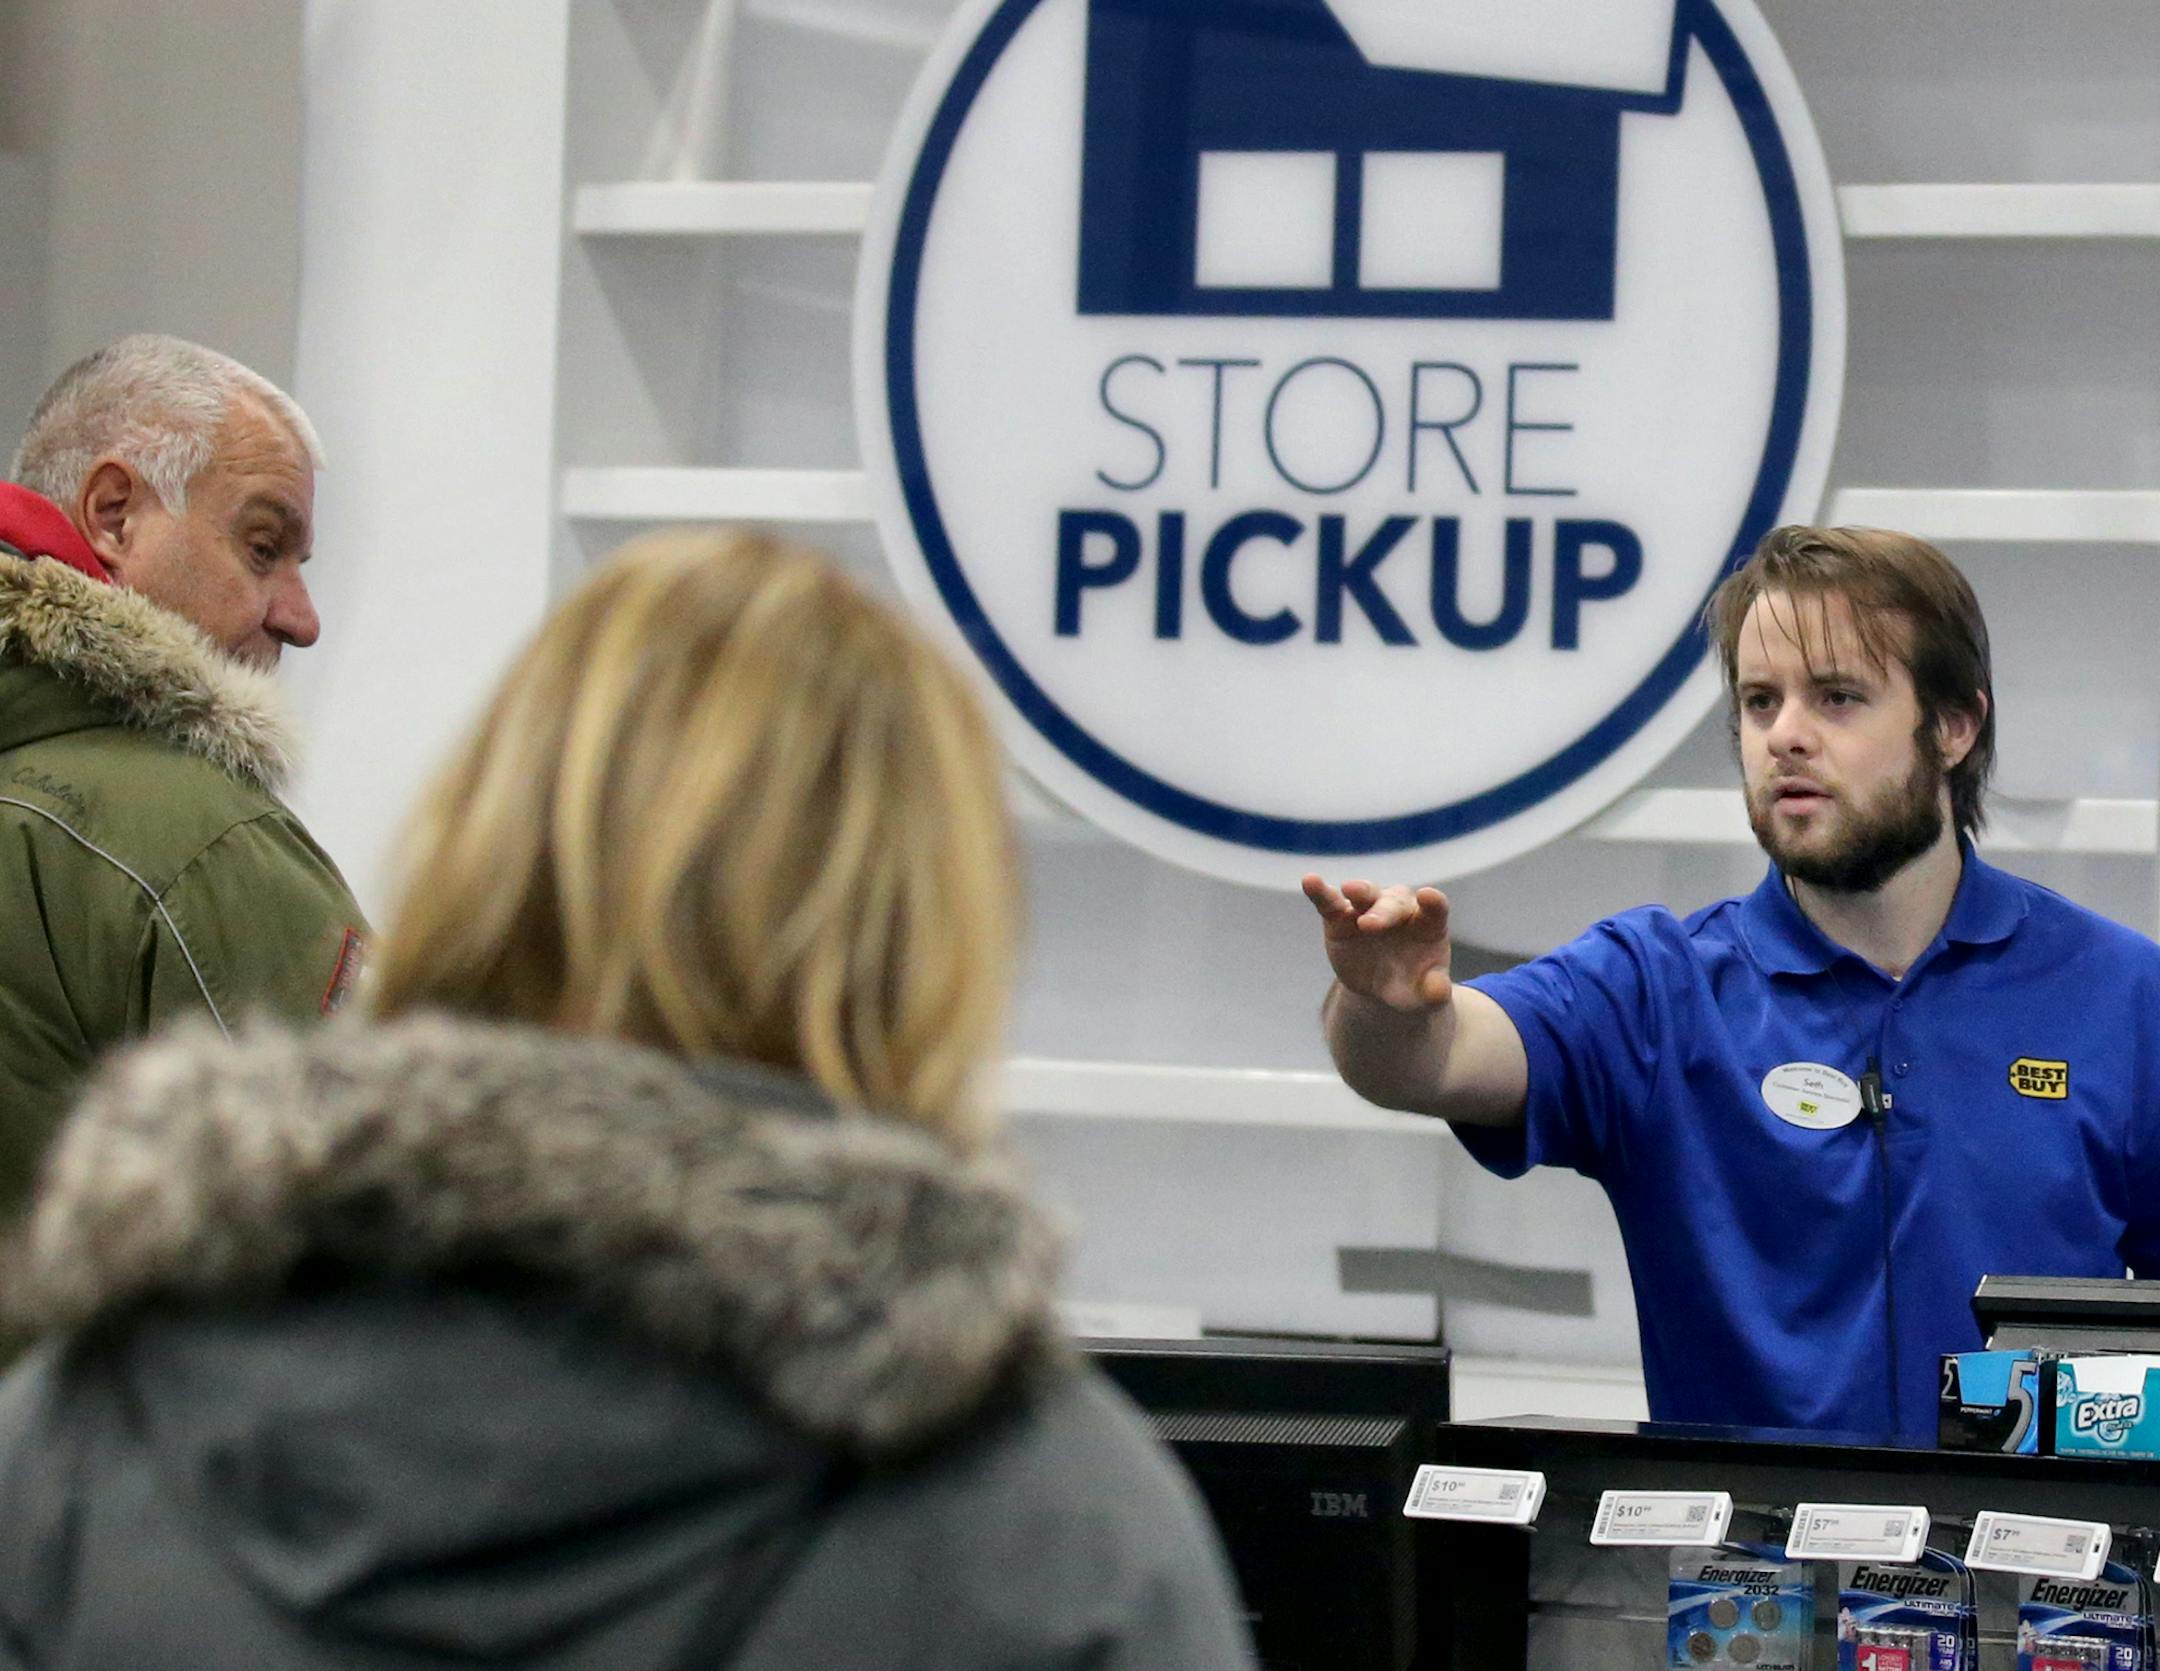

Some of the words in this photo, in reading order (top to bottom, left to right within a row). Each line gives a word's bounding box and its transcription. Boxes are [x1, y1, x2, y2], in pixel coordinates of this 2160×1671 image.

[1096, 353, 1580, 495] STORE
[1054, 508, 1644, 652] PICKUP
[2017, 1065, 2065, 1080] BEST
[2018, 1078, 2065, 1093] BUY
[2001, 1361, 2038, 1454] 5
[2078, 1397, 2139, 1429] Extra
[1310, 1492, 1368, 1517] IBM
[1698, 1565, 1776, 1586] Energizer
[1850, 1565, 1949, 1599] Energizer
[1744, 1584, 1780, 1596] 2032
[2031, 1578, 2128, 1611] Energizer
[1937, 1634, 1955, 1648] 20
[2115, 1646, 2133, 1660] 20
